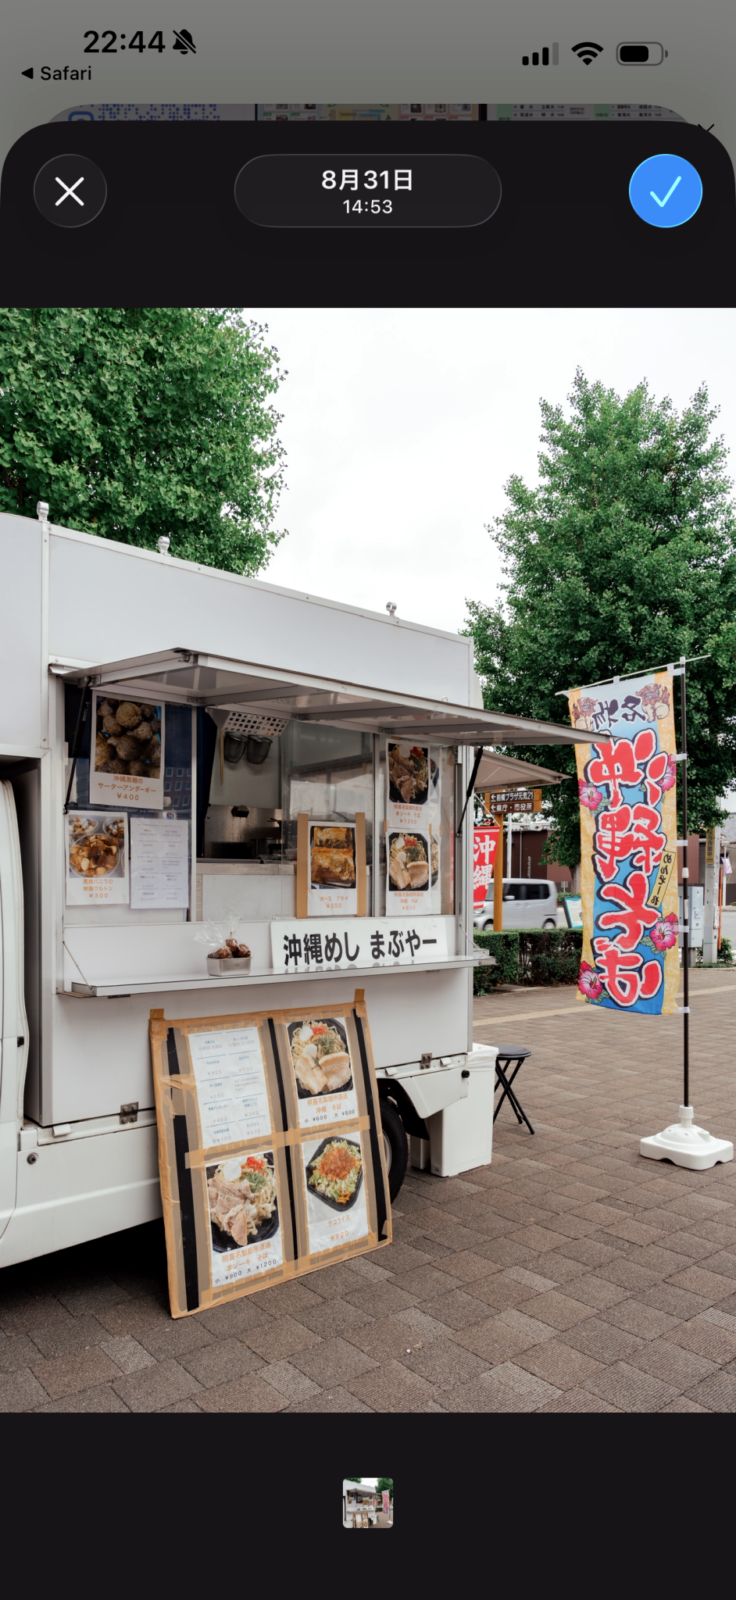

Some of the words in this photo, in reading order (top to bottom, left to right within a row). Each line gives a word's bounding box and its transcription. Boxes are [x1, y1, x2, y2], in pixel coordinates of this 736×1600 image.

[98, 782, 156, 793] サーターアンダーギー
[283, 931, 360, 966] 沖縄めし
[370, 929, 437, 960] まぶやー
[226, 1258, 251, 1272] 本ソーキ
[257, 1251, 269, 1261] そば
